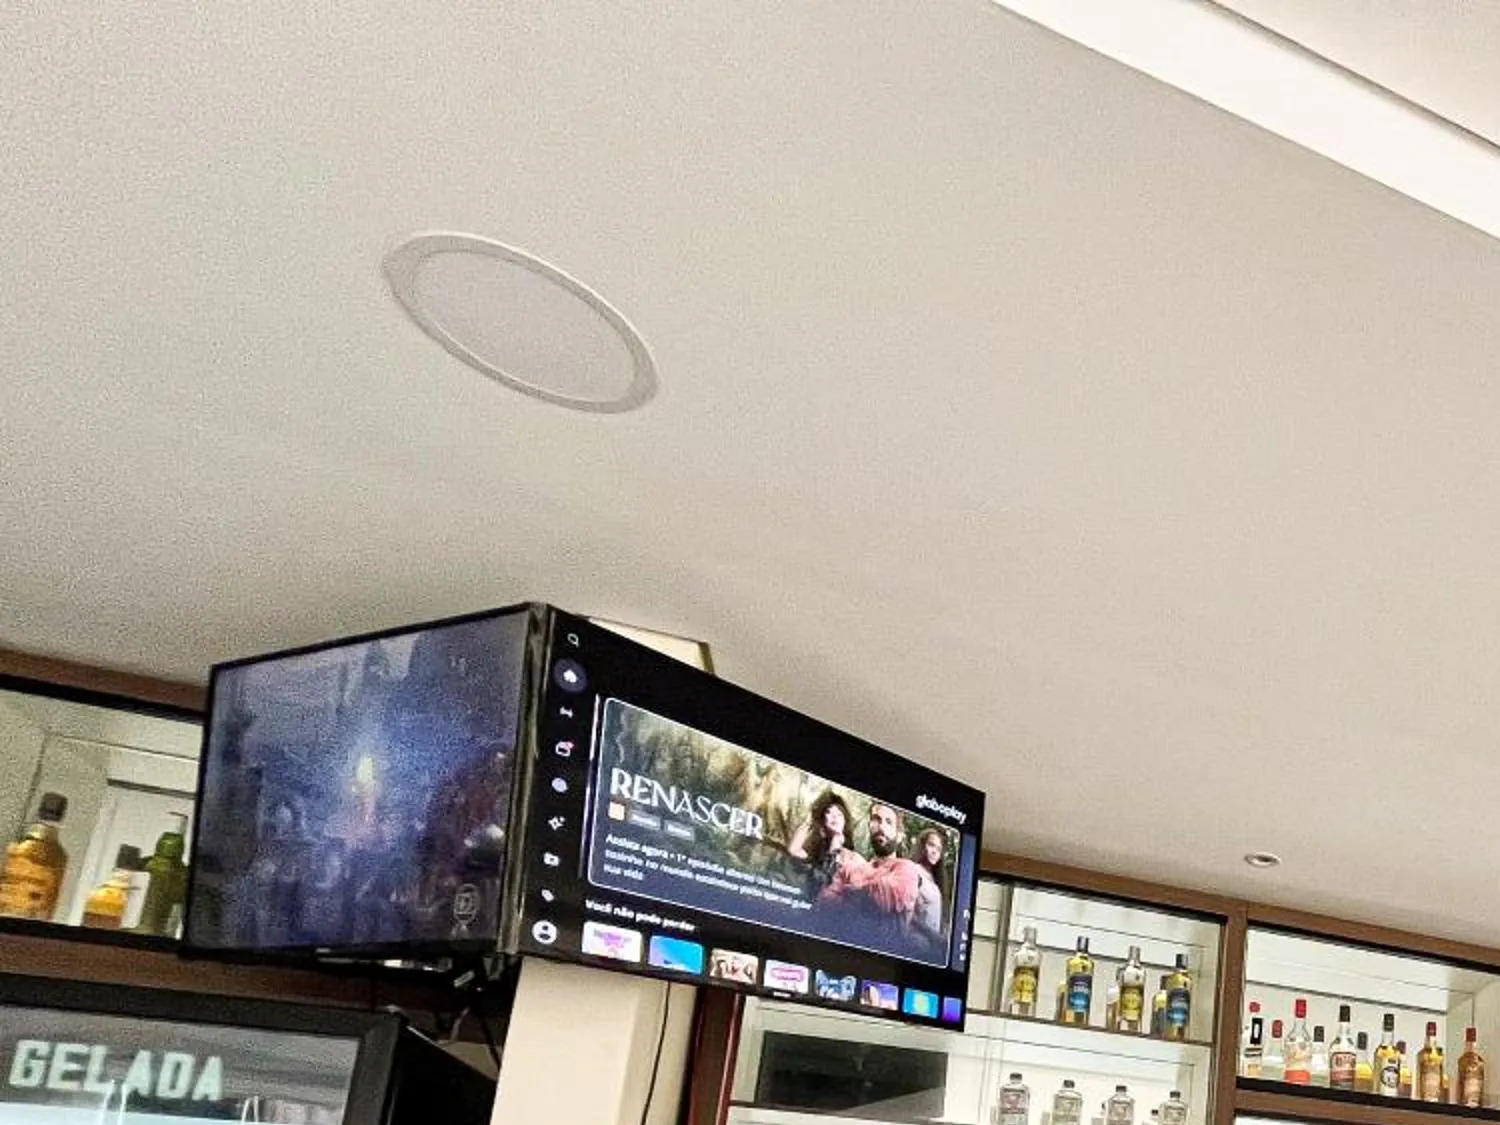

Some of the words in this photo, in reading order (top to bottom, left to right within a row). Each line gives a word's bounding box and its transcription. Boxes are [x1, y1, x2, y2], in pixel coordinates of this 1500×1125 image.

[610, 767, 764, 840] RENASCER
[915, 793, 967, 825] globoplay
[585, 899, 612, 914] Você
[613, 906, 635, 919] não
[8, 1039, 224, 1101] GELADA
